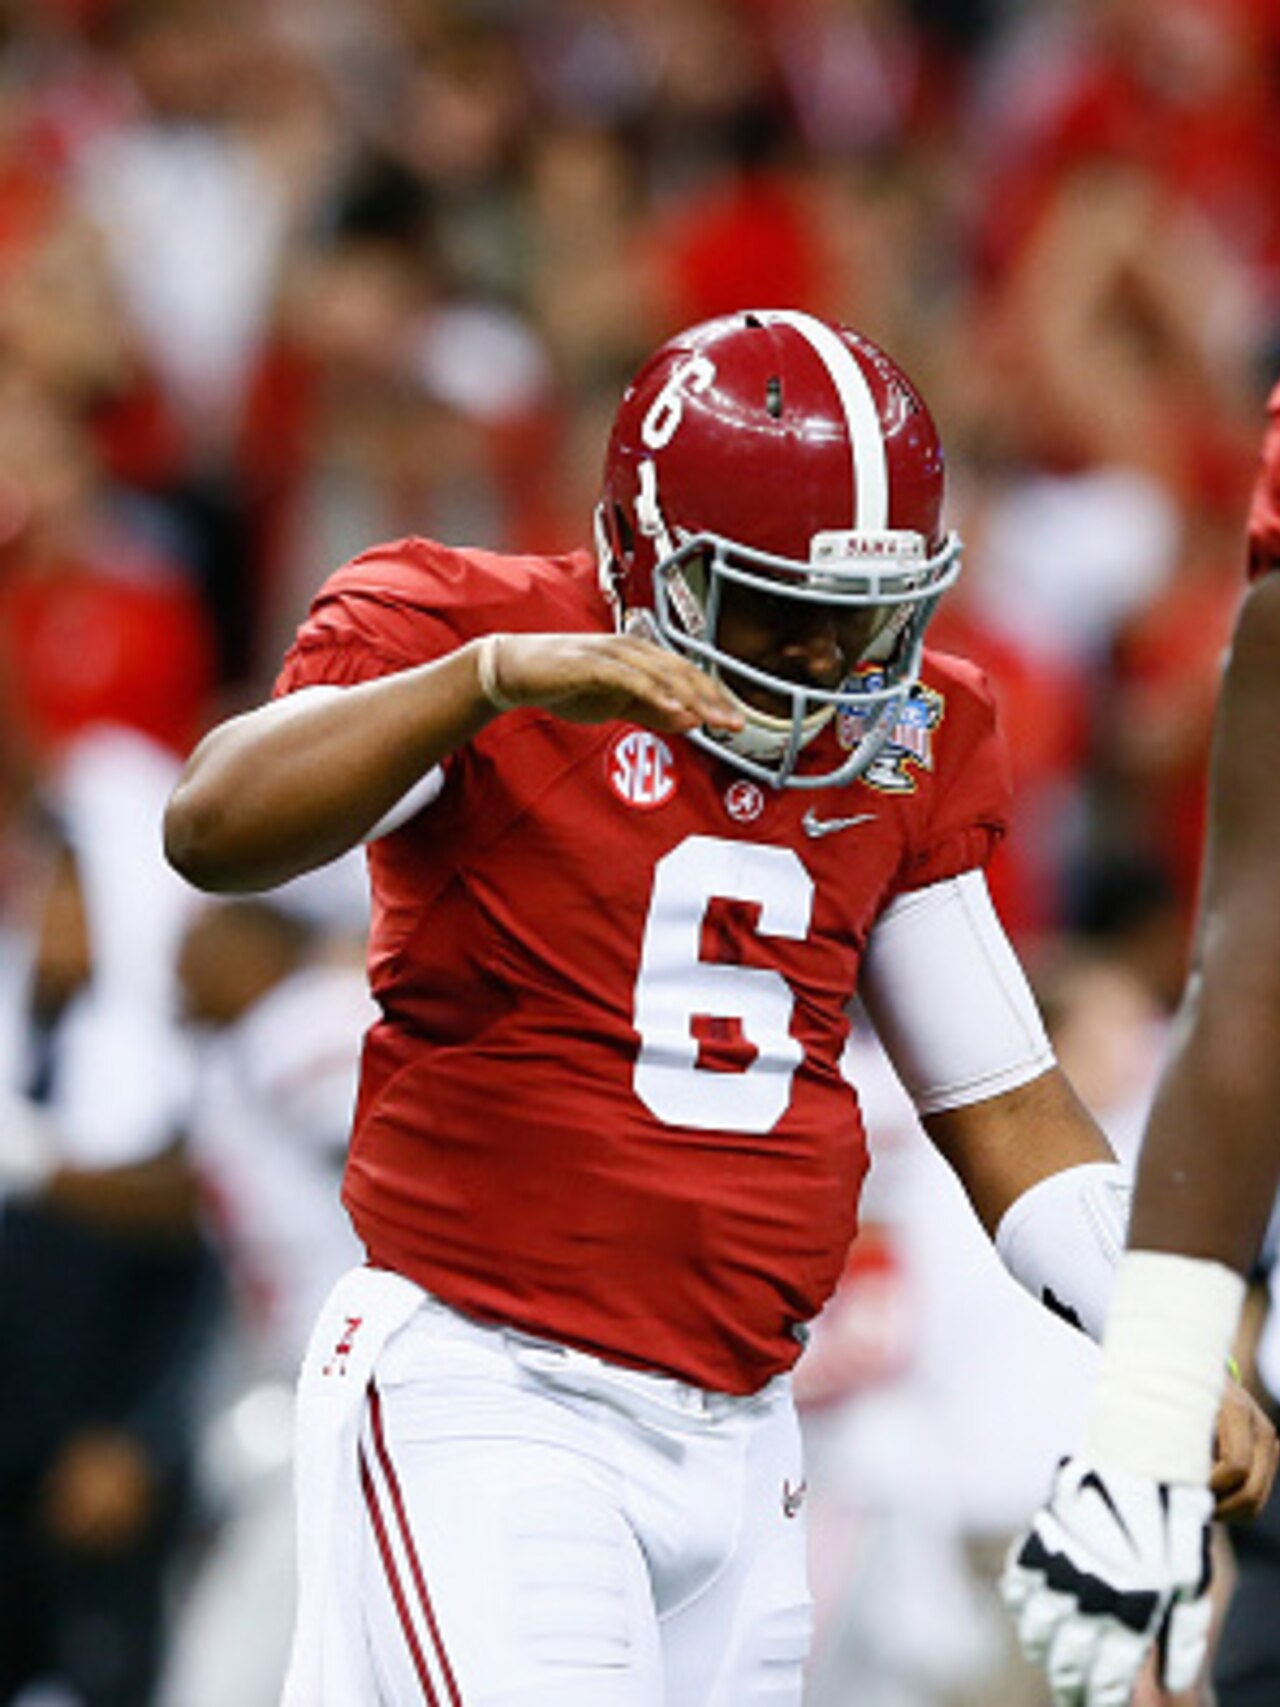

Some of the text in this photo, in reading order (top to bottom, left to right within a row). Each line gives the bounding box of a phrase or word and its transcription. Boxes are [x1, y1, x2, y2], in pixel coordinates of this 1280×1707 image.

[641, 356, 717, 450] 6
[611, 731, 674, 803] SEC
[632, 833, 815, 1134] 6
